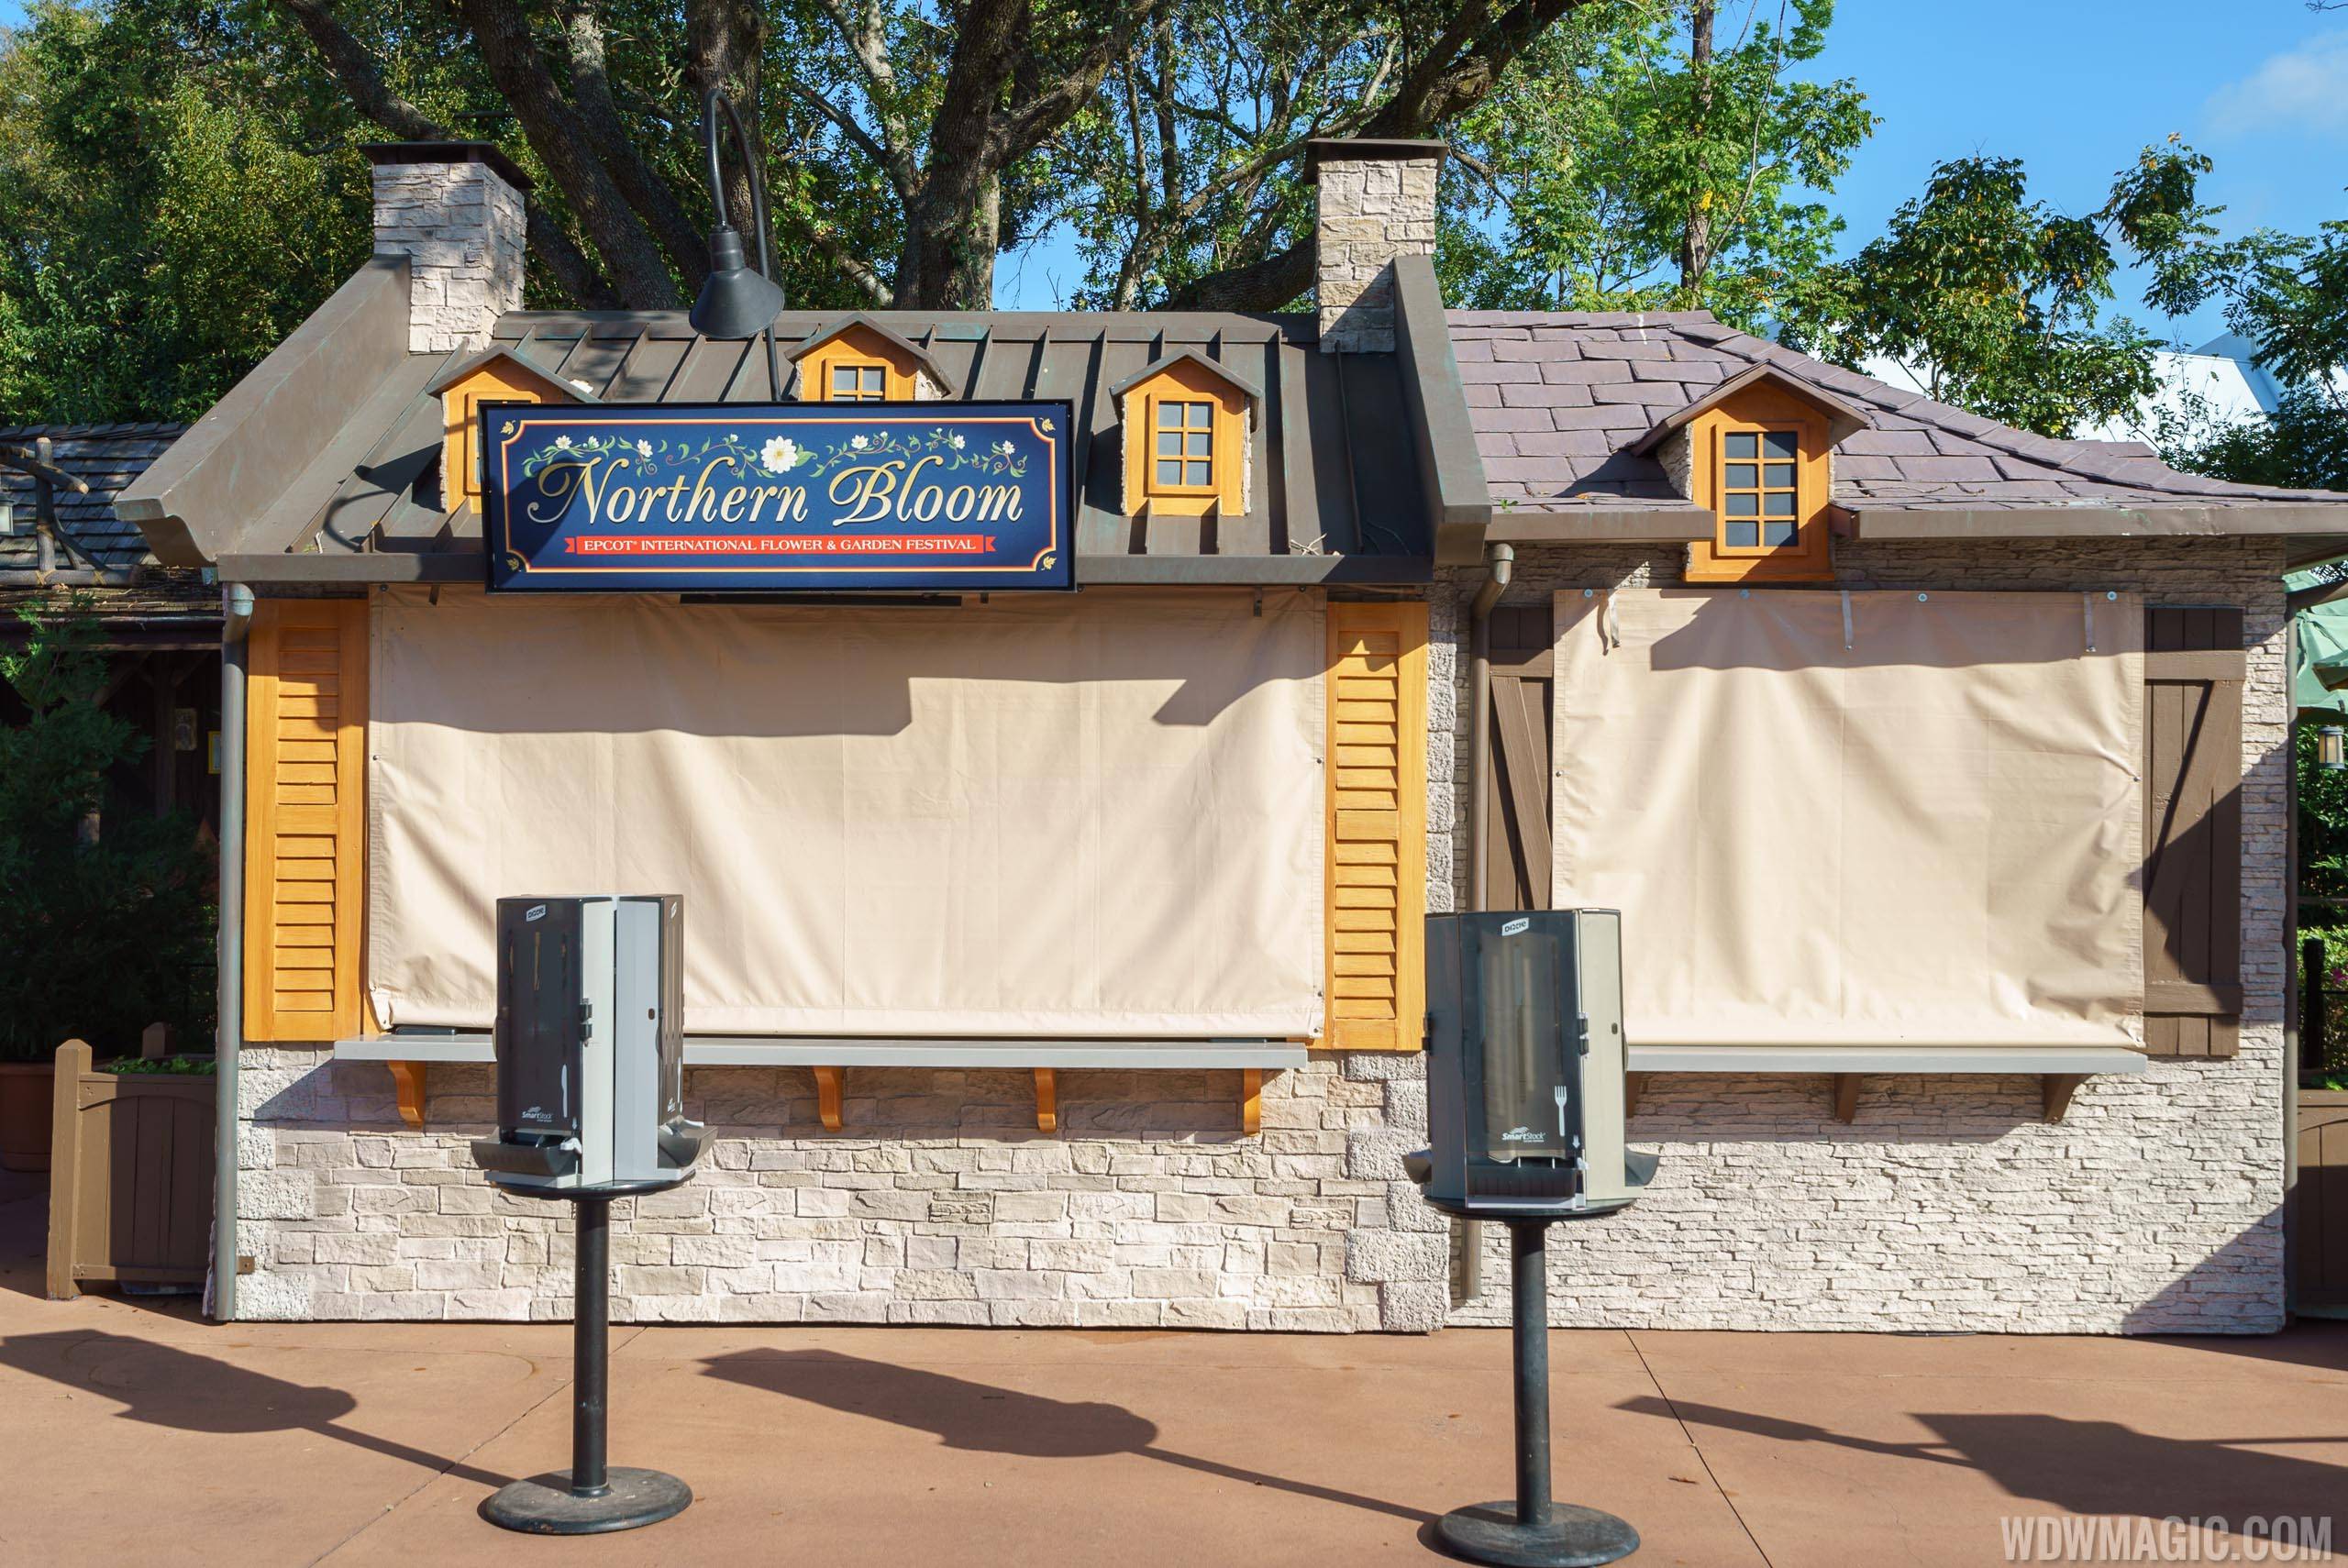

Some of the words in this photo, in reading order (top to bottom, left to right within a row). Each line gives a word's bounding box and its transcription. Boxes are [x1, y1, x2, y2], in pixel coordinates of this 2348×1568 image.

[526, 456, 809, 525] Northern
[828, 455, 1023, 527] Bloom
[641, 538, 757, 551] INTERNATIONAL
[760, 539, 823, 550] FLOWER
[826, 538, 836, 550] &
[840, 539, 902, 550] GARDEN
[906, 538, 976, 550] FESTIVAL
